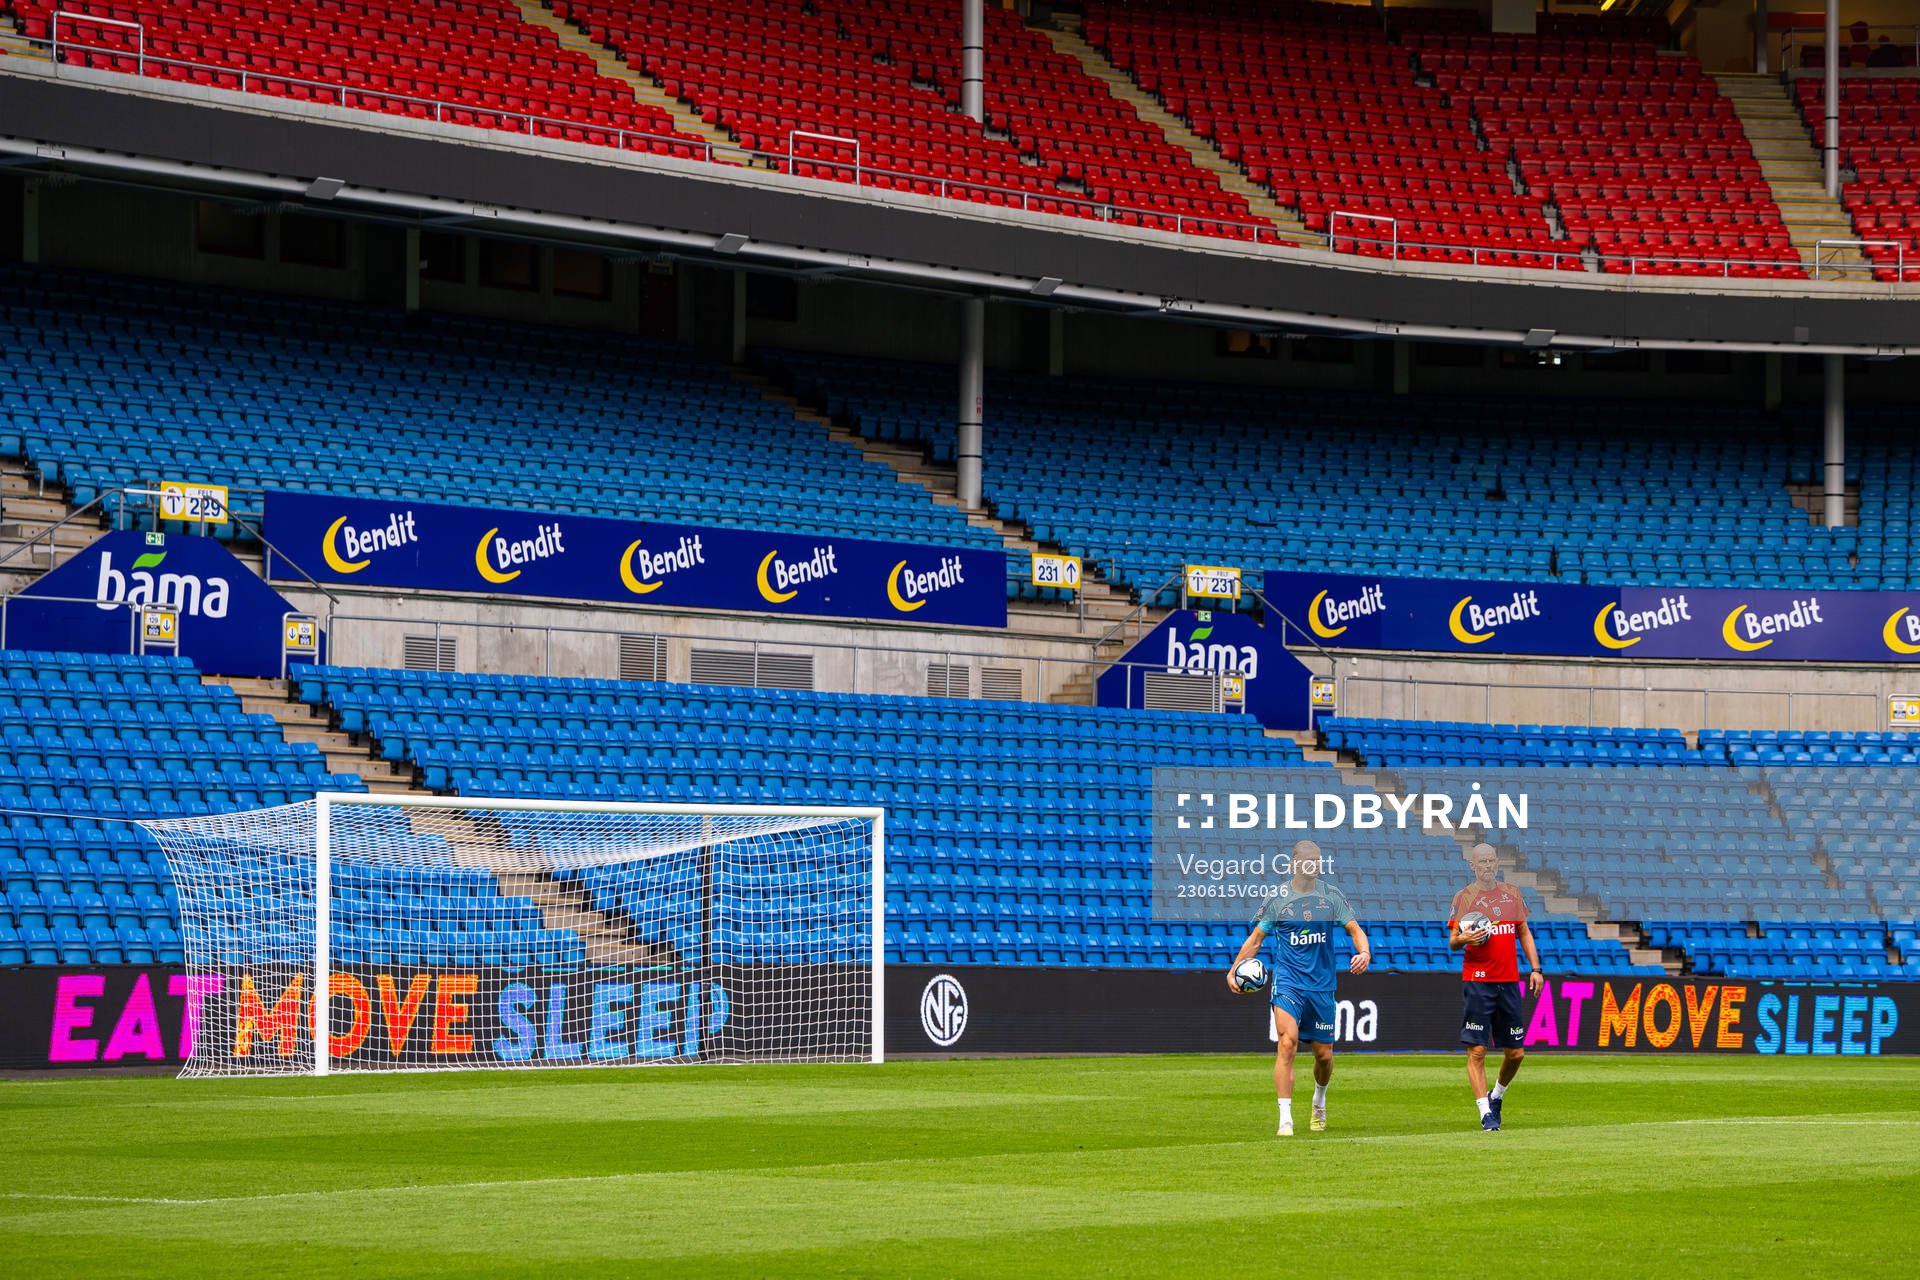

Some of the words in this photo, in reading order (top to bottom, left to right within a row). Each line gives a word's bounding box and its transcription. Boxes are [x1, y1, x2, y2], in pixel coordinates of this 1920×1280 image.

[190, 496, 221, 517] 229
[344, 511, 418, 558] Bendit
[495, 522, 565, 569] Bendit
[638, 534, 705, 580] Bendit
[774, 545, 838, 590] Bendit
[904, 555, 964, 599] Bendit
[1038, 565, 1058, 581] 231
[96, 551, 229, 618] bama
[1211, 577, 1234, 594] 231
[1325, 584, 1386, 626] Bendit
[1469, 590, 1541, 632] Bendit
[1613, 594, 1692, 637] Bendit
[1744, 597, 1824, 640] Bendit
[1167, 627, 1258, 680] bama
[1490, 923, 1516, 935] ama
[48, 973, 224, 1062] EAT
[233, 973, 479, 1058] MOVE
[492, 981, 730, 1061] SLEEP
[1518, 980, 1595, 1047] AT
[1598, 982, 1747, 1049] MOVE
[1754, 993, 1898, 1056] SLEEP
